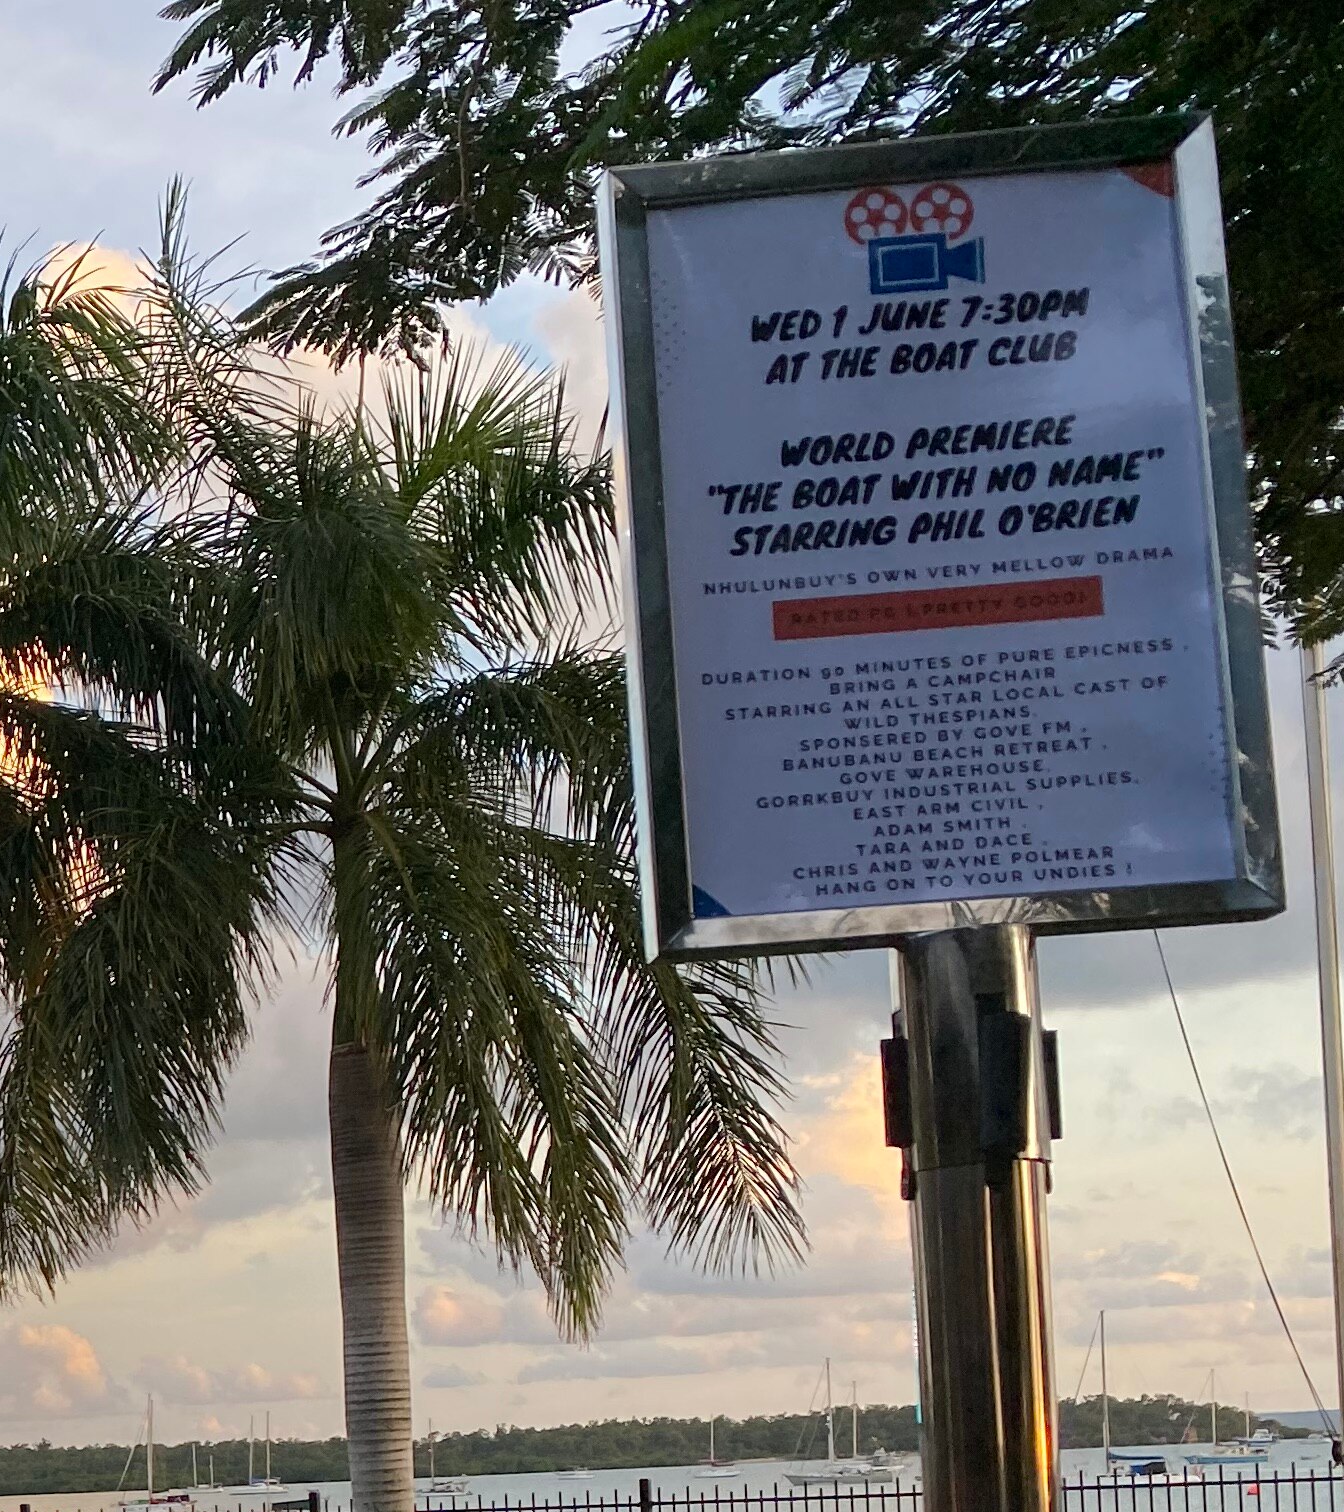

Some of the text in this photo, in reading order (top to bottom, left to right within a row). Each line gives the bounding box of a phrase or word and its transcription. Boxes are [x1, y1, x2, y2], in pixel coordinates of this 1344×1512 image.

[751, 287, 1090, 343] WED 1 JUNE 7:30PM
[765, 330, 1078, 385] AT THE BOAT CLUB
[780, 414, 1077, 468] WORLD PREMIERE
[708, 447, 1165, 516] "THE BOAT WITH NO NAME"
[728, 494, 1141, 557] STARRING PHIL O'BRIEN
[867, 568, 918, 584] OWN
[926, 563, 981, 579] VERY
[991, 554, 1085, 574] MELLOW
[1096, 546, 1173, 565] DRAMA
[701, 667, 811, 686] DURATION
[855, 656, 951, 675] MINUTES
[961, 653, 987, 667] OF
[998, 648, 1055, 665] PURE
[1065, 637, 1173, 659] EPICNESS
[725, 675, 1167, 721] STARRING AN ALL STAR LOCAL CAST OF
[829, 666, 1055, 696] BRING A CAMPCHAIR
[799, 720, 1071, 752] SPONSERED BY GOVE FM
[843, 714, 899, 730] WILD
[782, 736, 1092, 772] BANUBANU BEACH RETREAT
[839, 769, 896, 785] GOVE
[884, 780, 1016, 800] INDUSTRIAL
[853, 797, 1029, 821] EAST ARM CIVIL
[874, 816, 1011, 837] ADAM SMITH
[855, 832, 1033, 857] TARA AND DACE
[792, 845, 1114, 880] CHRIS AND WAYNE POLMEAR
[815, 863, 1116, 896] HANG ON TO YOUR UNDIES
